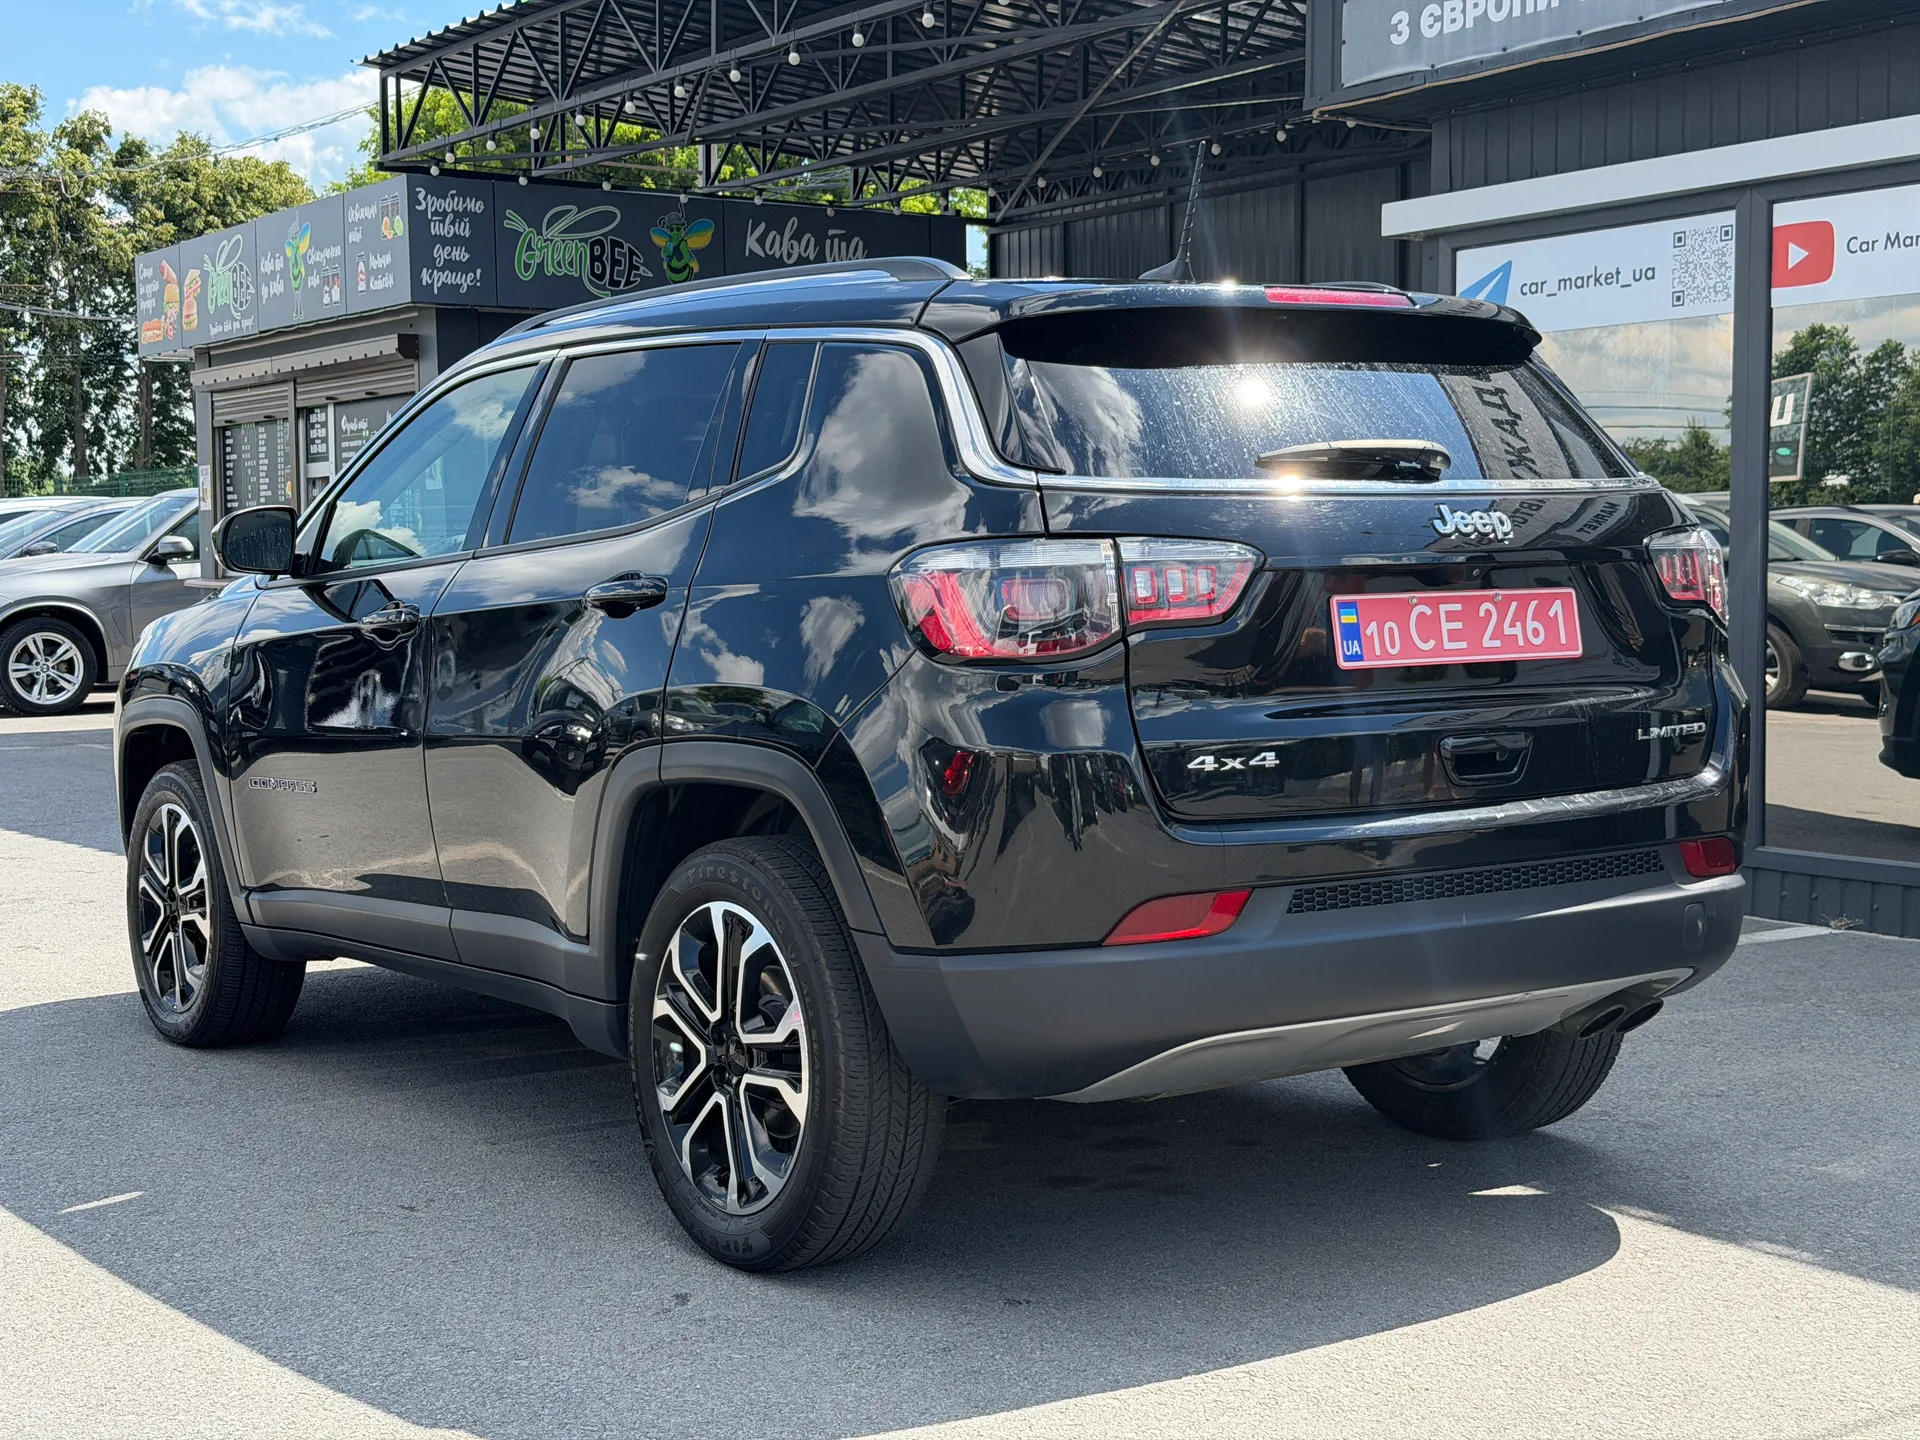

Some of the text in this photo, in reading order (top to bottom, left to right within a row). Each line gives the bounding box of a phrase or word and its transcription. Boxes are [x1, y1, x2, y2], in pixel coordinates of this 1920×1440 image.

[1389, 0, 1559, 45] З ЄВРОП
[415, 187, 485, 219] Зробимо
[431, 213, 471, 238] твій
[433, 244, 470, 267] день
[745, 217, 868, 265] Кава та
[1846, 236, 1879, 254] Car
[420, 267, 481, 295] краще!
[1520, 266, 1656, 297] car_market_ua
[1430, 503, 1514, 544] Jeep
[1343, 599, 1567, 657] UA 10 CE 2461
[1637, 721, 1706, 741] LIMITED
[1186, 751, 1280, 771] 4x4
[248, 776, 317, 793] COMPASS
[686, 865, 785, 934] Firestone
